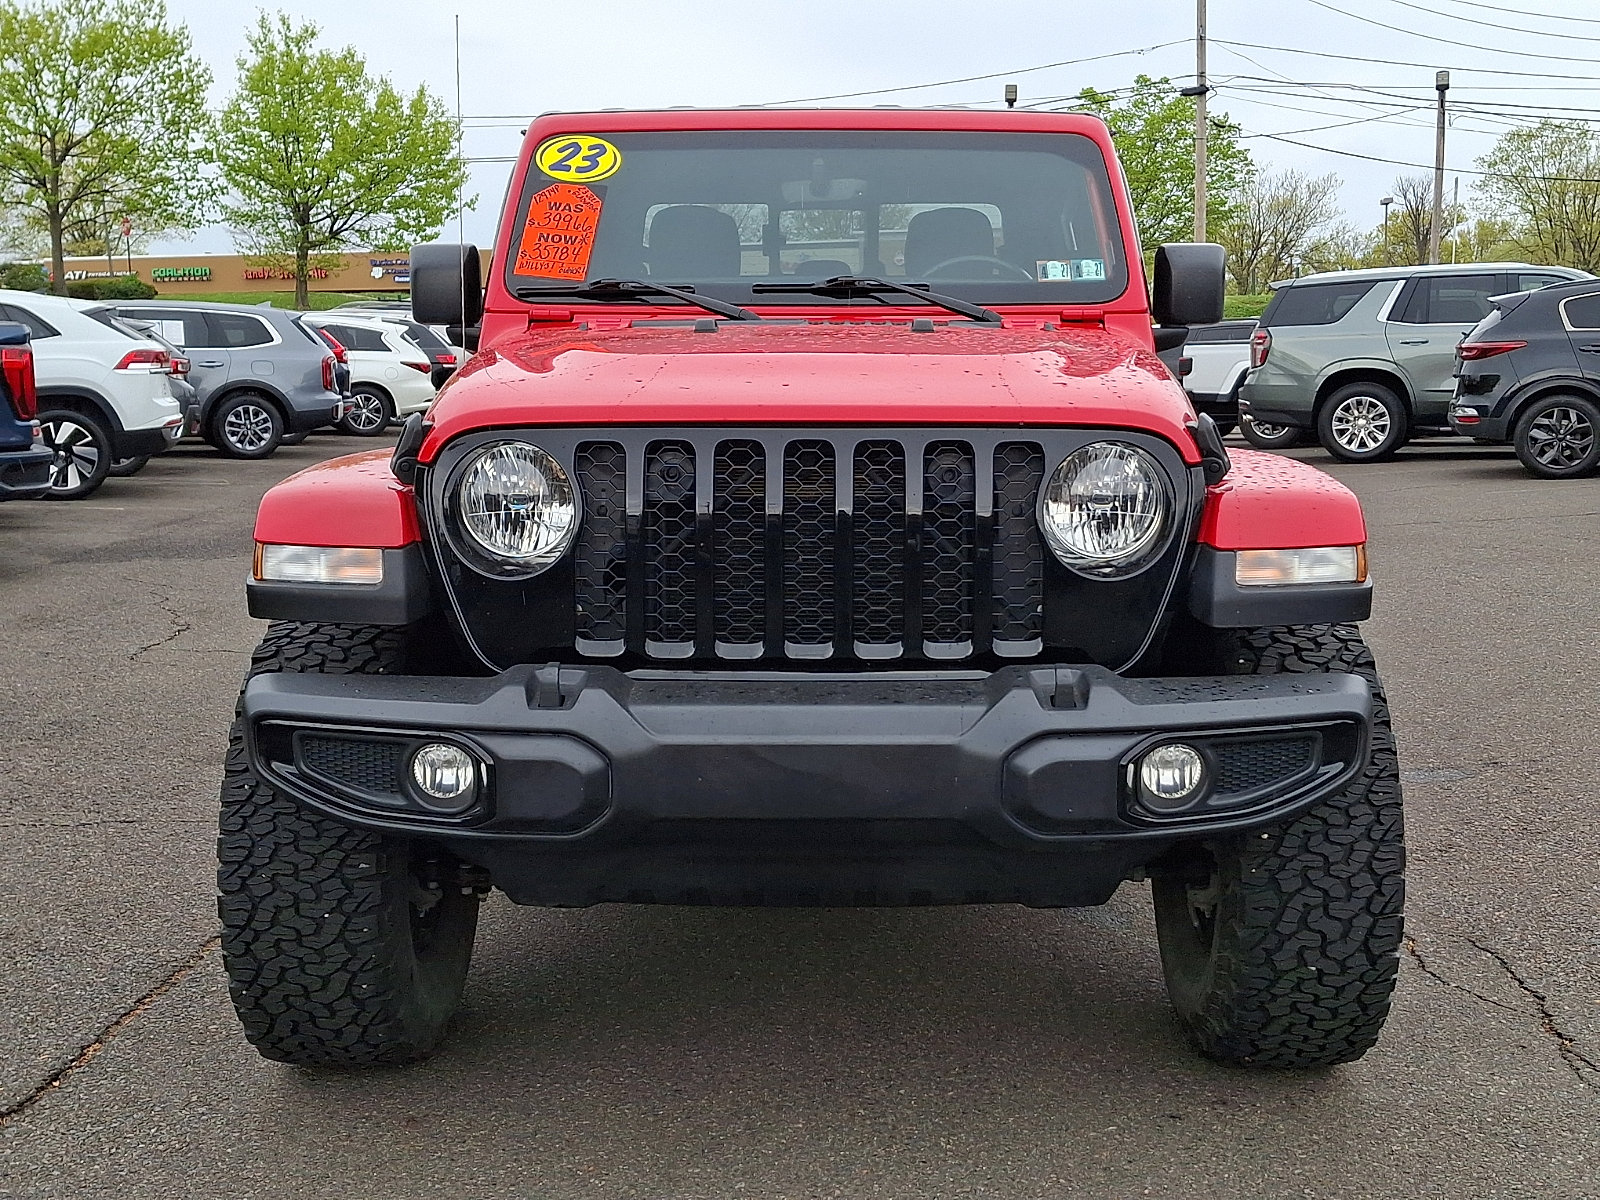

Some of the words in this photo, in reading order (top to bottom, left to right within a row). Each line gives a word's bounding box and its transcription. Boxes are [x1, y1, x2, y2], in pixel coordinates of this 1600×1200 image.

[549, 141, 608, 174] 23
[548, 201, 585, 214] WAS
[64, 270, 87, 280] ATI
